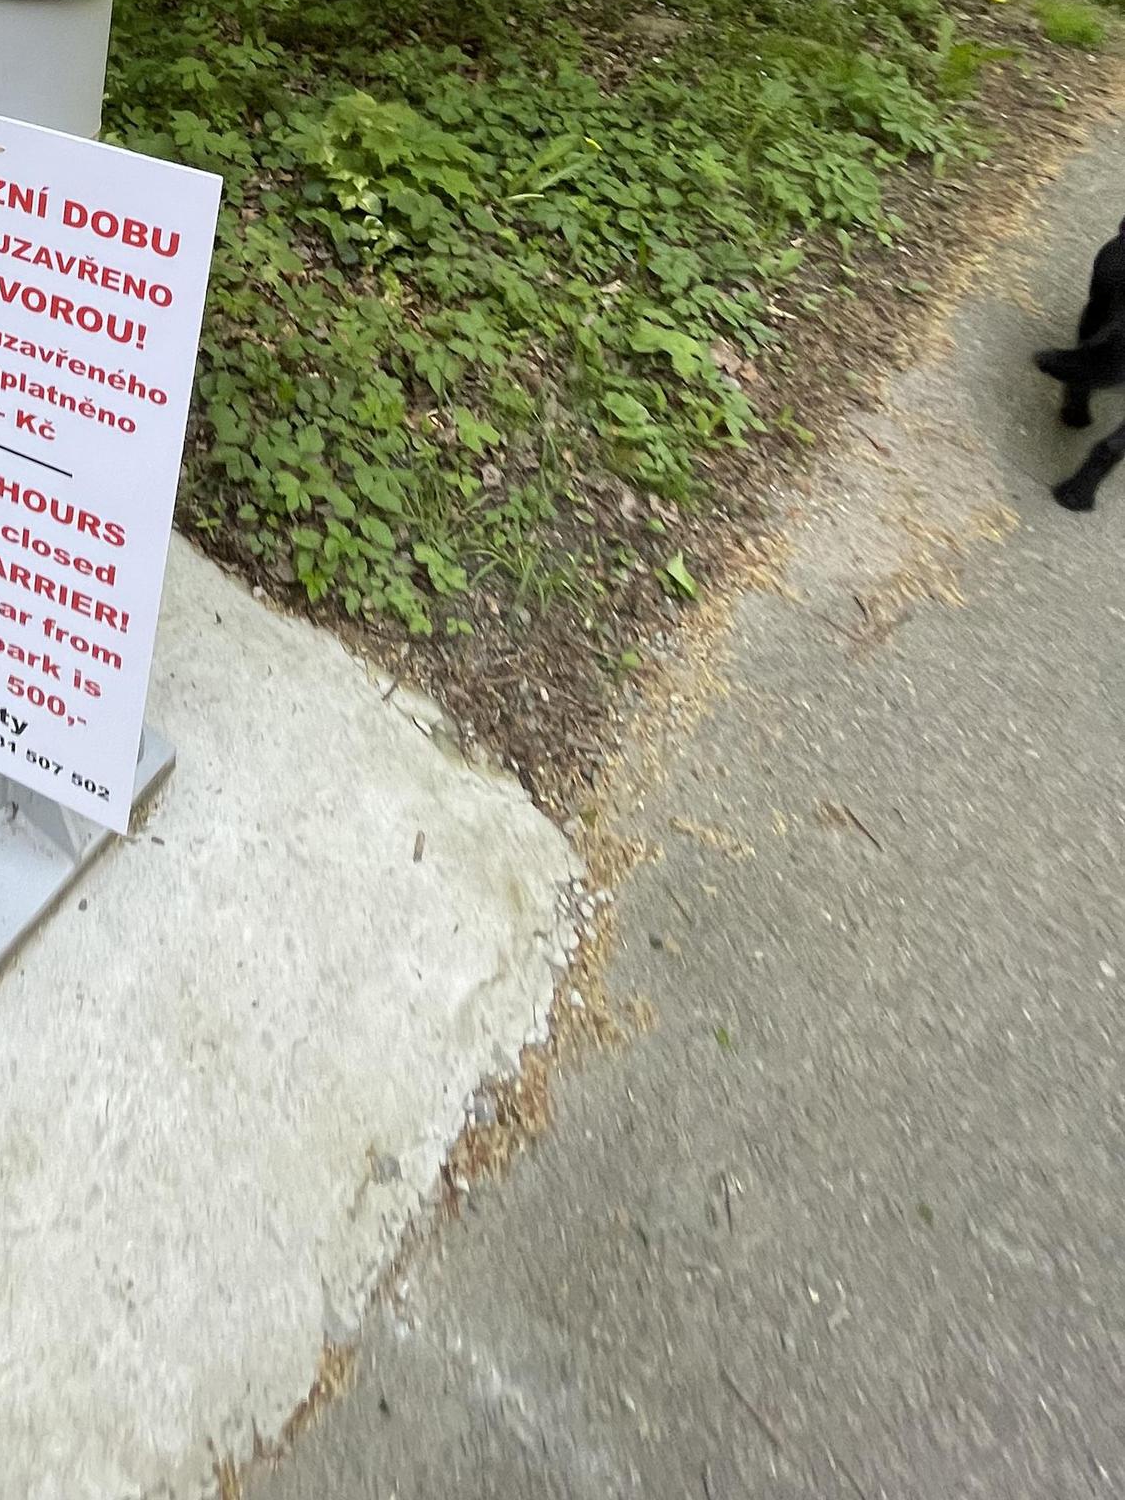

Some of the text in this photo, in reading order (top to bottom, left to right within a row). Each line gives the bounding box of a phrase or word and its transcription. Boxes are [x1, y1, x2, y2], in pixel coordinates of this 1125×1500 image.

[62, 199, 181, 258] DOBU
[15, 408, 56, 441] Kč
[0, 525, 117, 587] closed
[42, 617, 122, 671] from
[7, 674, 87, 727] 500,-
[73, 668, 102, 698] is
[25, 748, 64, 776] 507
[71, 772, 110, 802] 502
